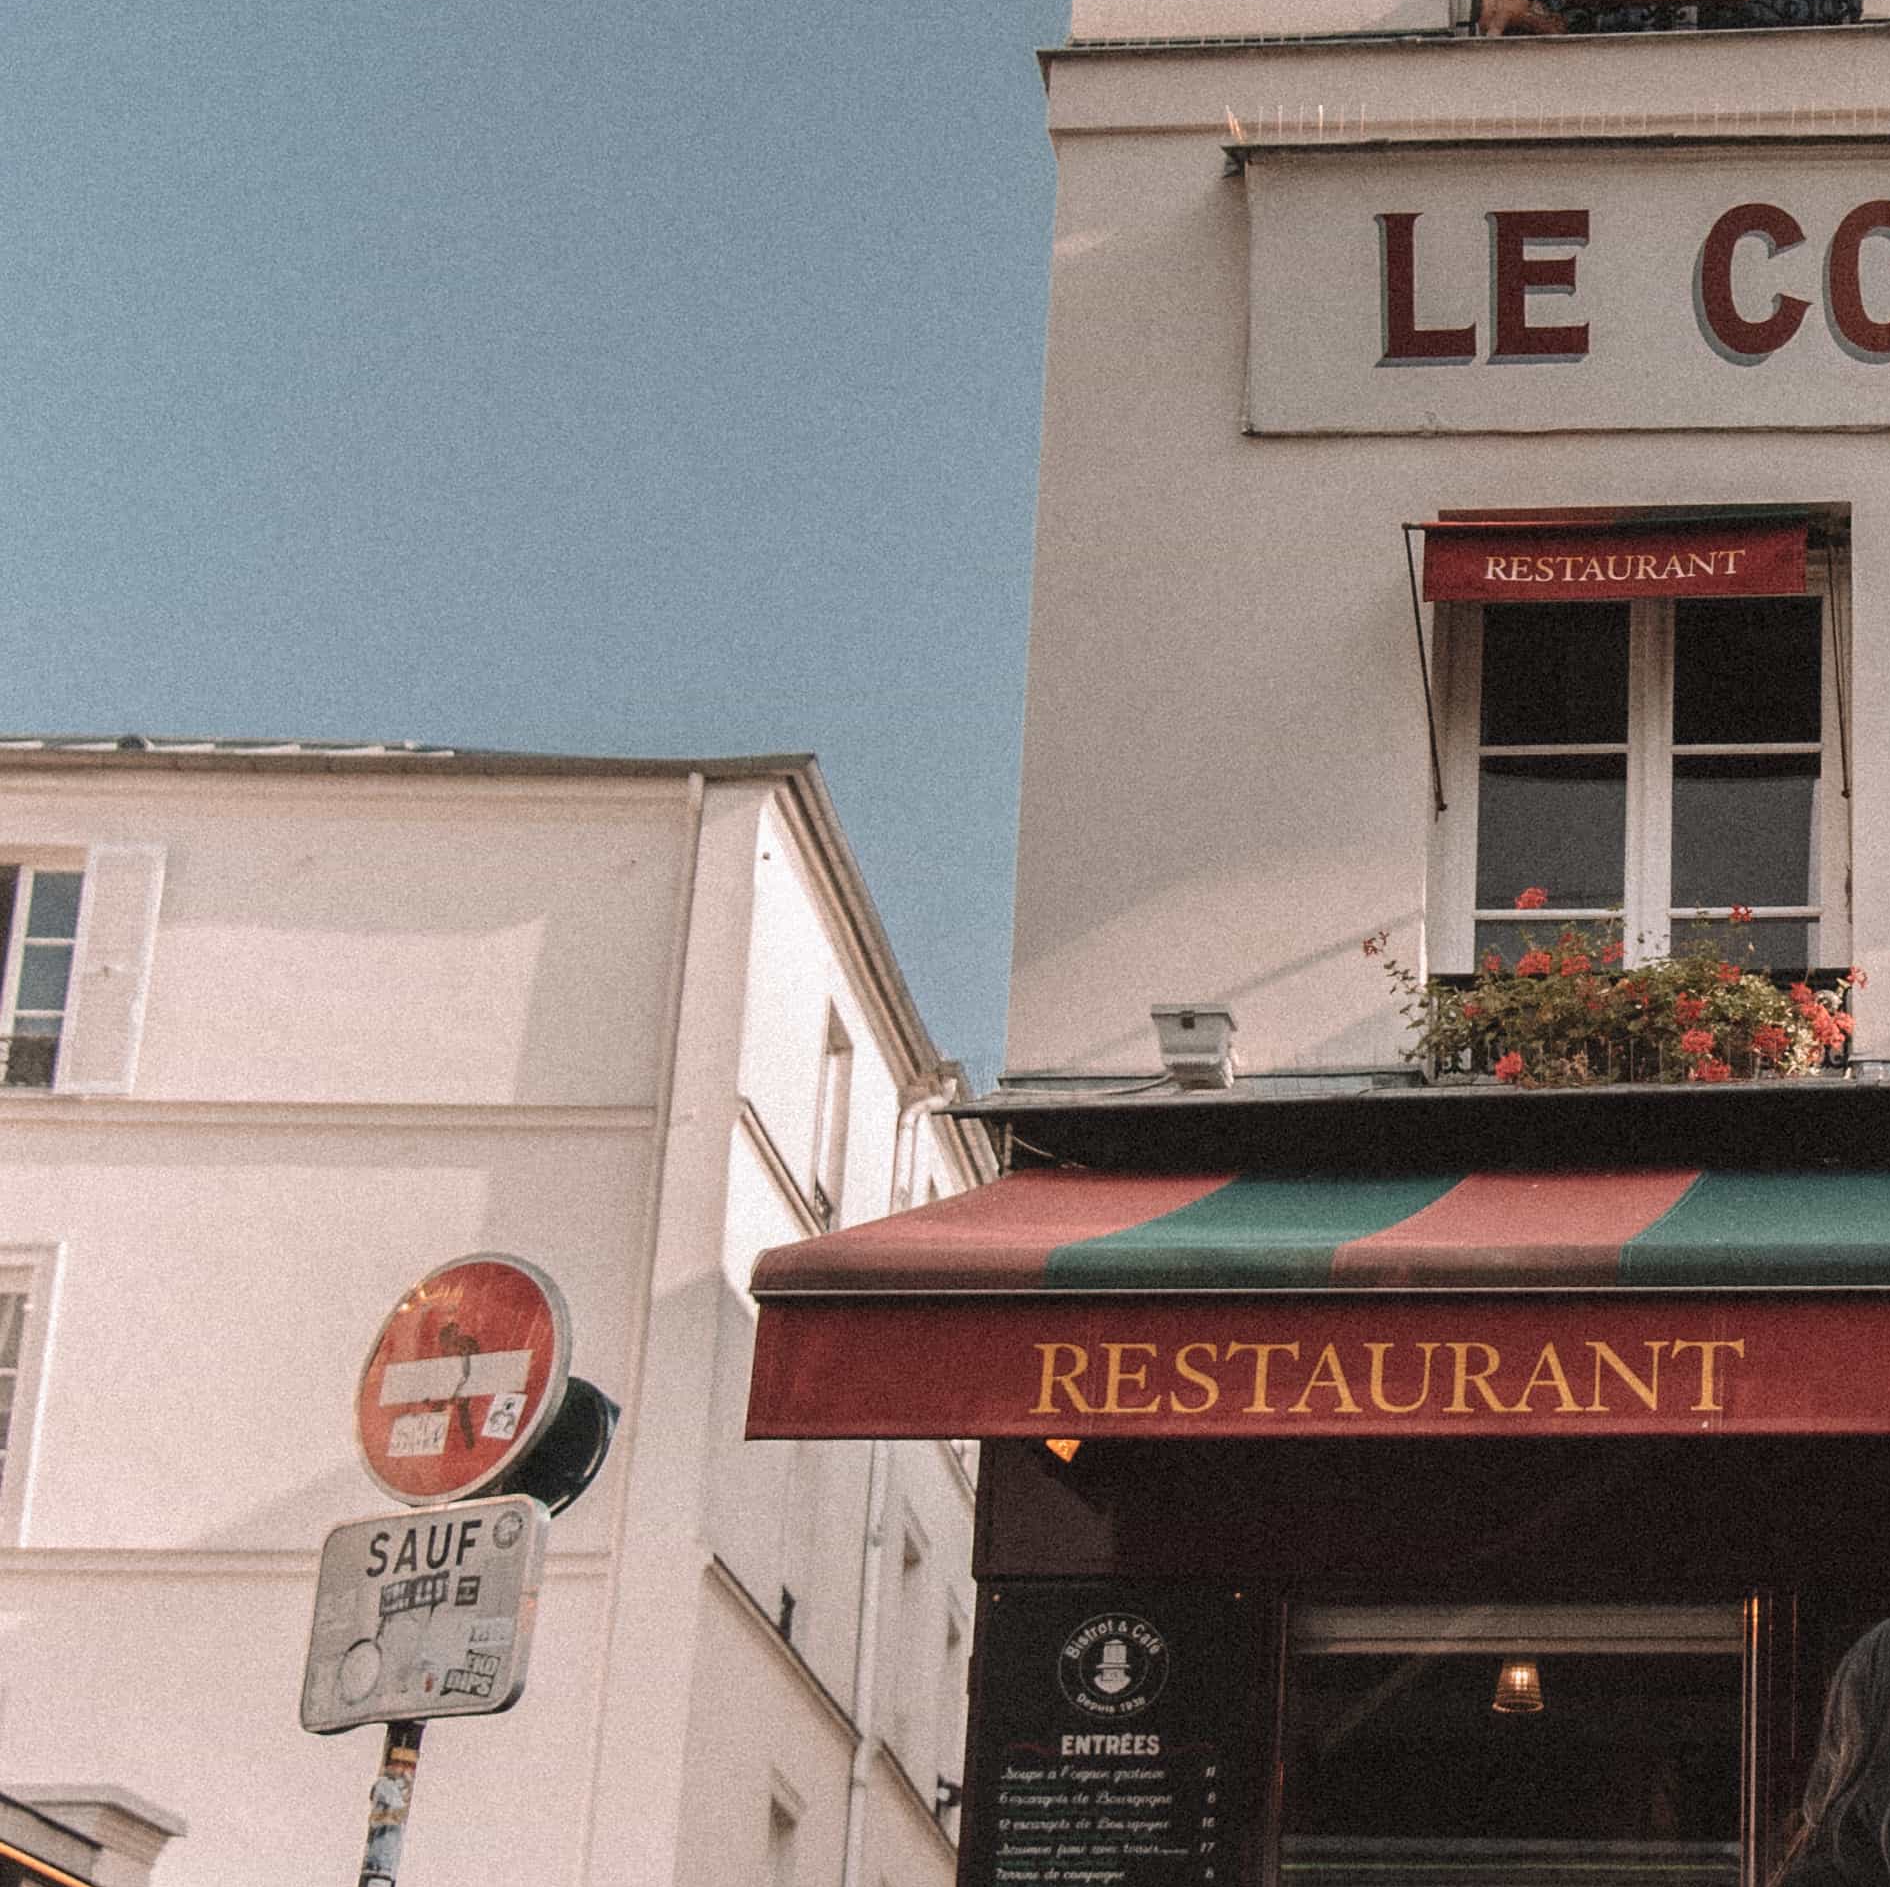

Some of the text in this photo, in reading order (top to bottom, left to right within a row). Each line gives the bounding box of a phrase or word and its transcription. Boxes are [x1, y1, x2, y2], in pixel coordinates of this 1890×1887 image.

[1376, 210, 1590, 365] LE
[1484, 550, 1745, 582] RESTAURANT
[1029, 1337, 1745, 1415] RESTAURANT
[366, 1518, 482, 1578] SAUF
[1065, 1619, 1114, 1659] Bistrot
[1118, 1620, 1128, 1633] &
[1061, 1732, 1161, 1756] ENTRÉES
